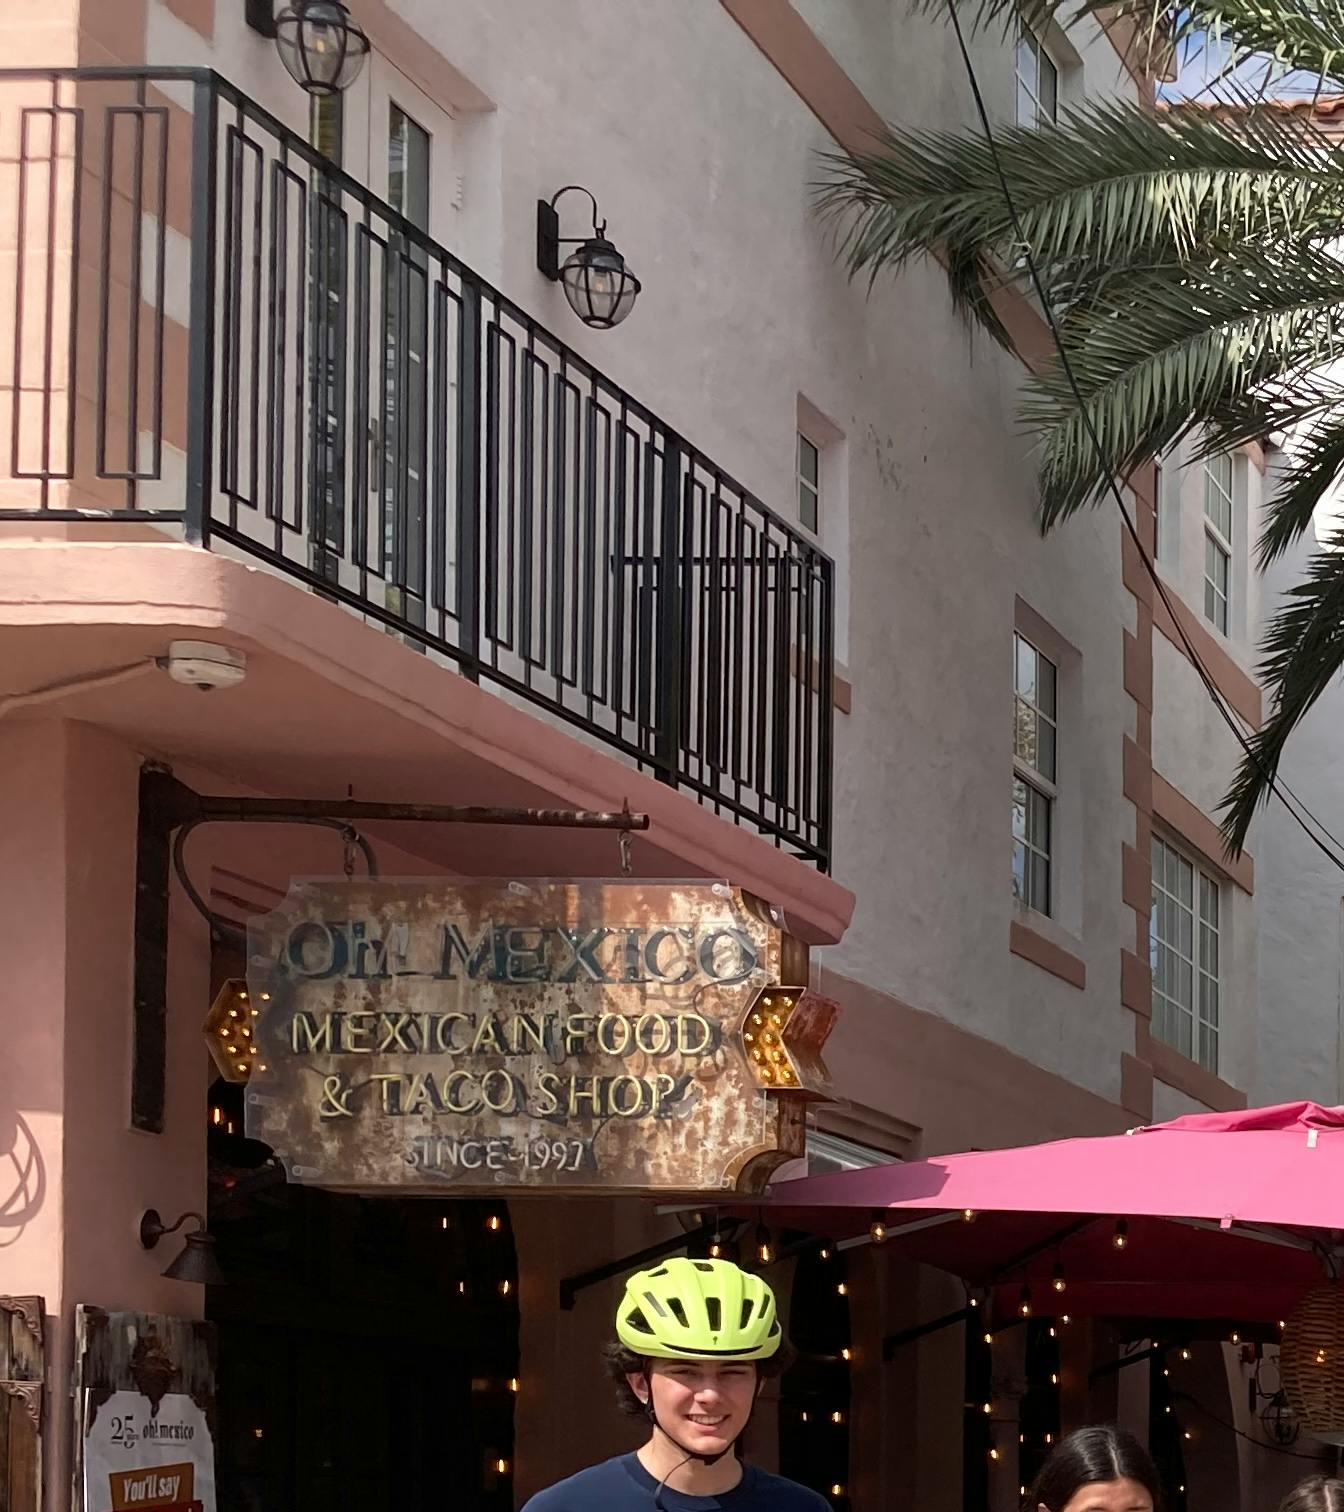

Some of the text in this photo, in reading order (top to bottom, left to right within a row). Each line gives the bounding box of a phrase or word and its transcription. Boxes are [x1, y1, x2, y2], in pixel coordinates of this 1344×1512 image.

[434, 920, 757, 985] MEXICO
[291, 1011, 713, 1056] MEXICAN FOOD
[319, 1070, 678, 1120] & TACO SHOP
[111, 1415, 134, 1449] 25
[123, 1474, 181, 1503] You'll say
